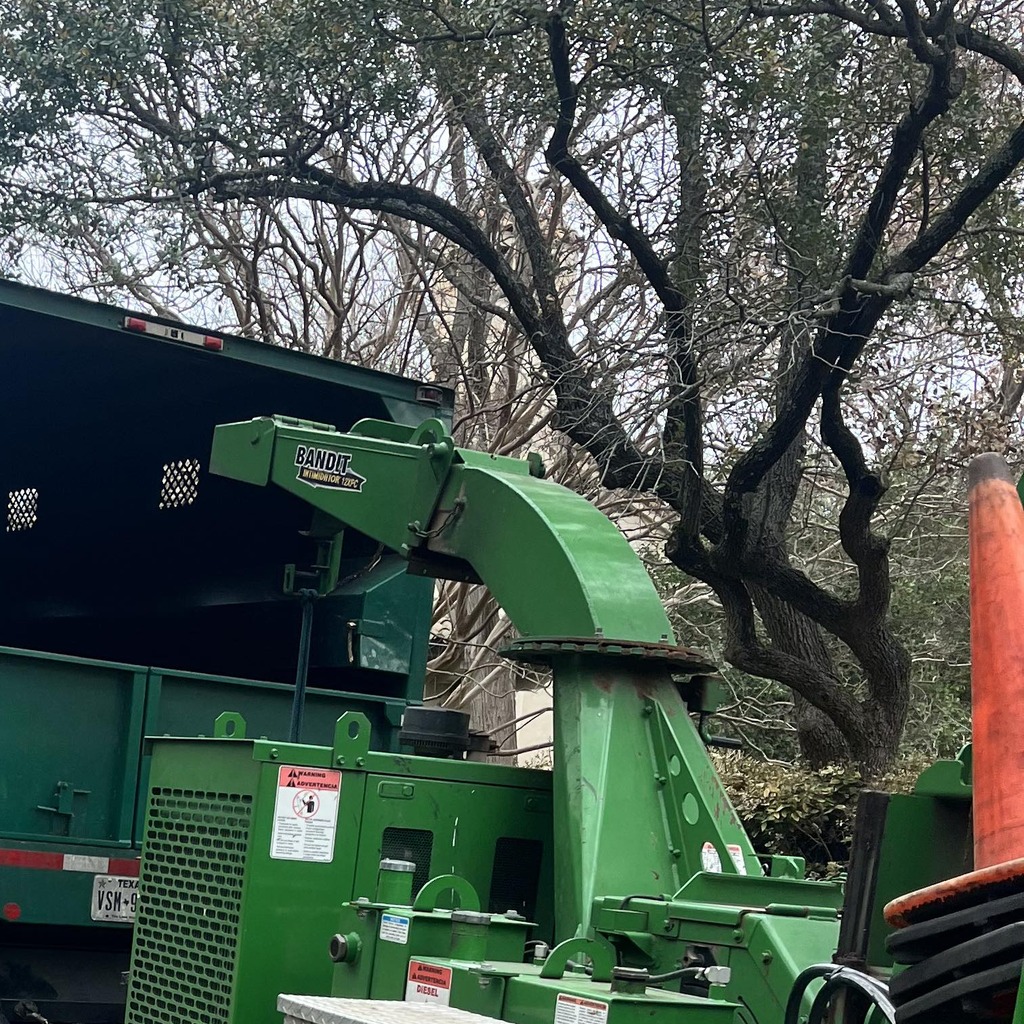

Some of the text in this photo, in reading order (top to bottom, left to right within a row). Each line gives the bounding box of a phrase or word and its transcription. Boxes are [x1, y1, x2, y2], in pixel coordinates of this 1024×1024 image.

[295, 445, 352, 475] BANDIT
[298, 770, 326, 778] WARNING
[296, 780, 337, 789] ADVERTENCIA
[118, 879, 139, 889] TEXA
[422, 966, 443, 975] WARNING
[417, 974, 446, 985] ADVERTENCIA
[417, 985, 438, 997] DIESEL
